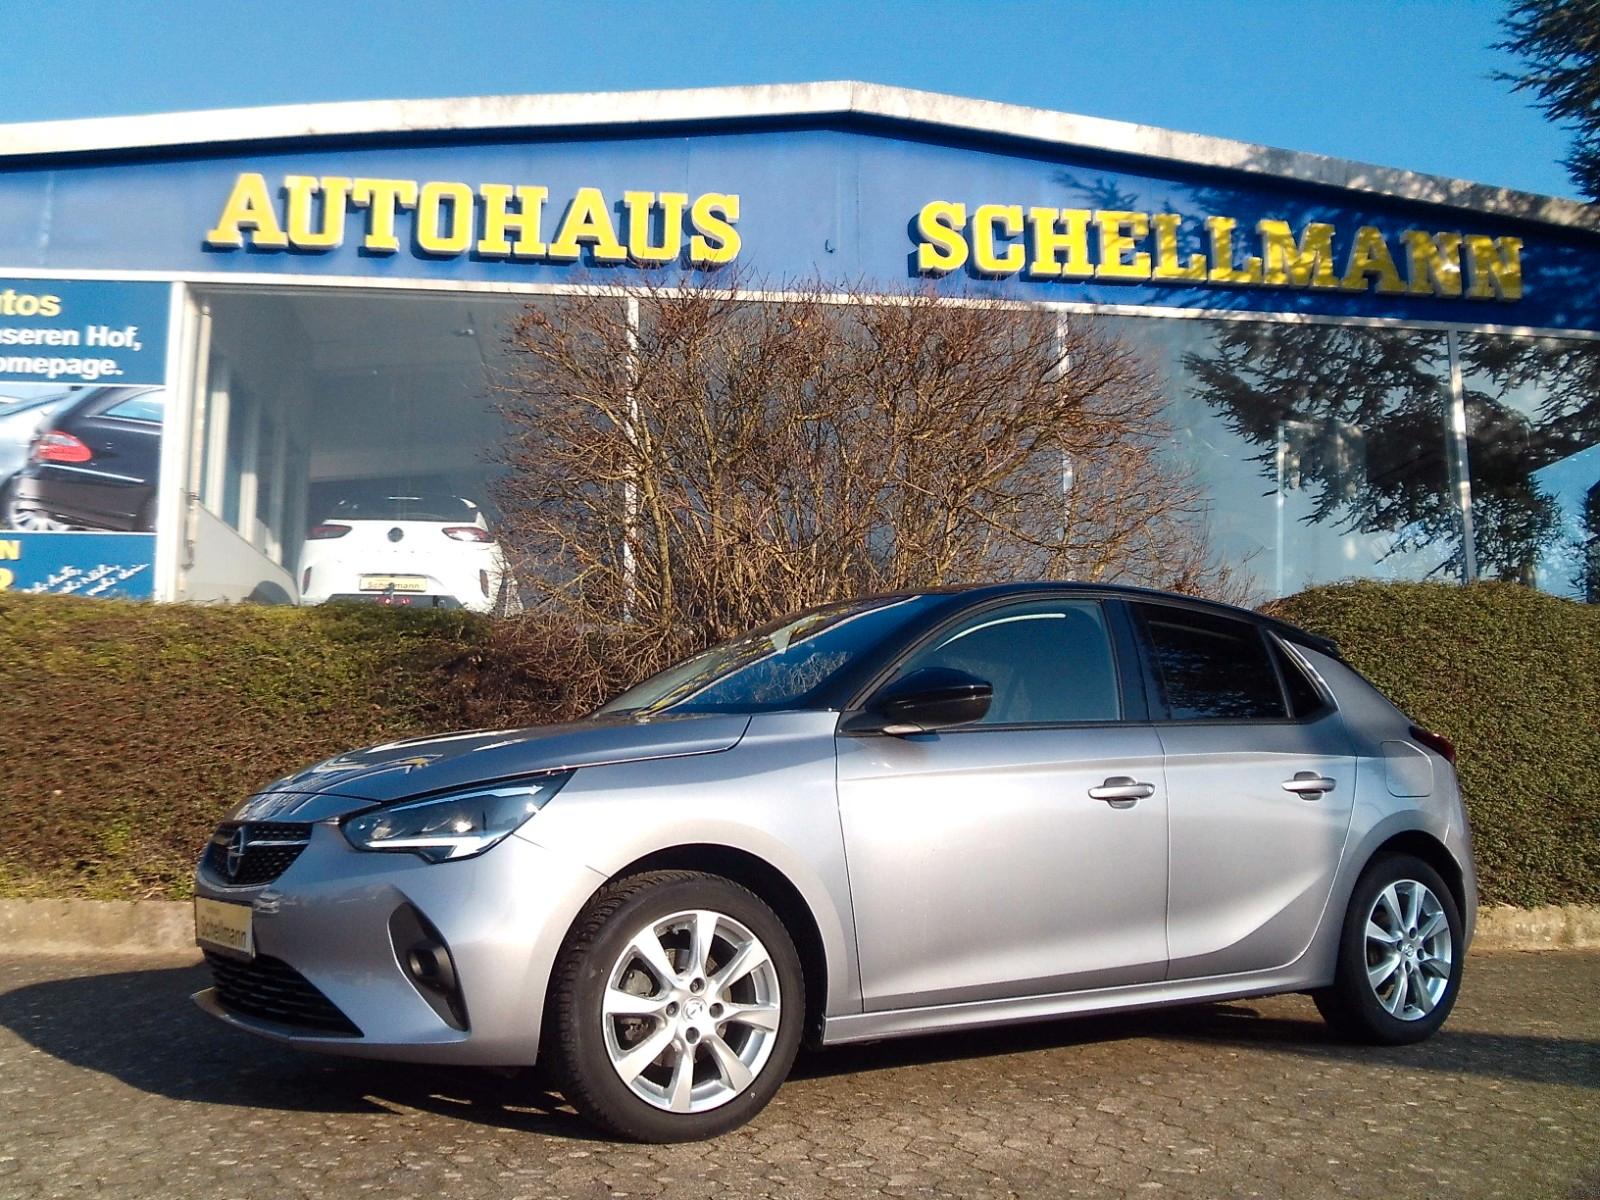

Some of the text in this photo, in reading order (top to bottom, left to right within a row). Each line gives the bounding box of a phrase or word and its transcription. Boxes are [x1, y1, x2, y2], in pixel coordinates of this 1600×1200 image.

[207, 172, 1523, 299] AUTOHAUS SCHELLMANN
[0, 289, 62, 317] tos
[0, 324, 142, 351] seren Hof,
